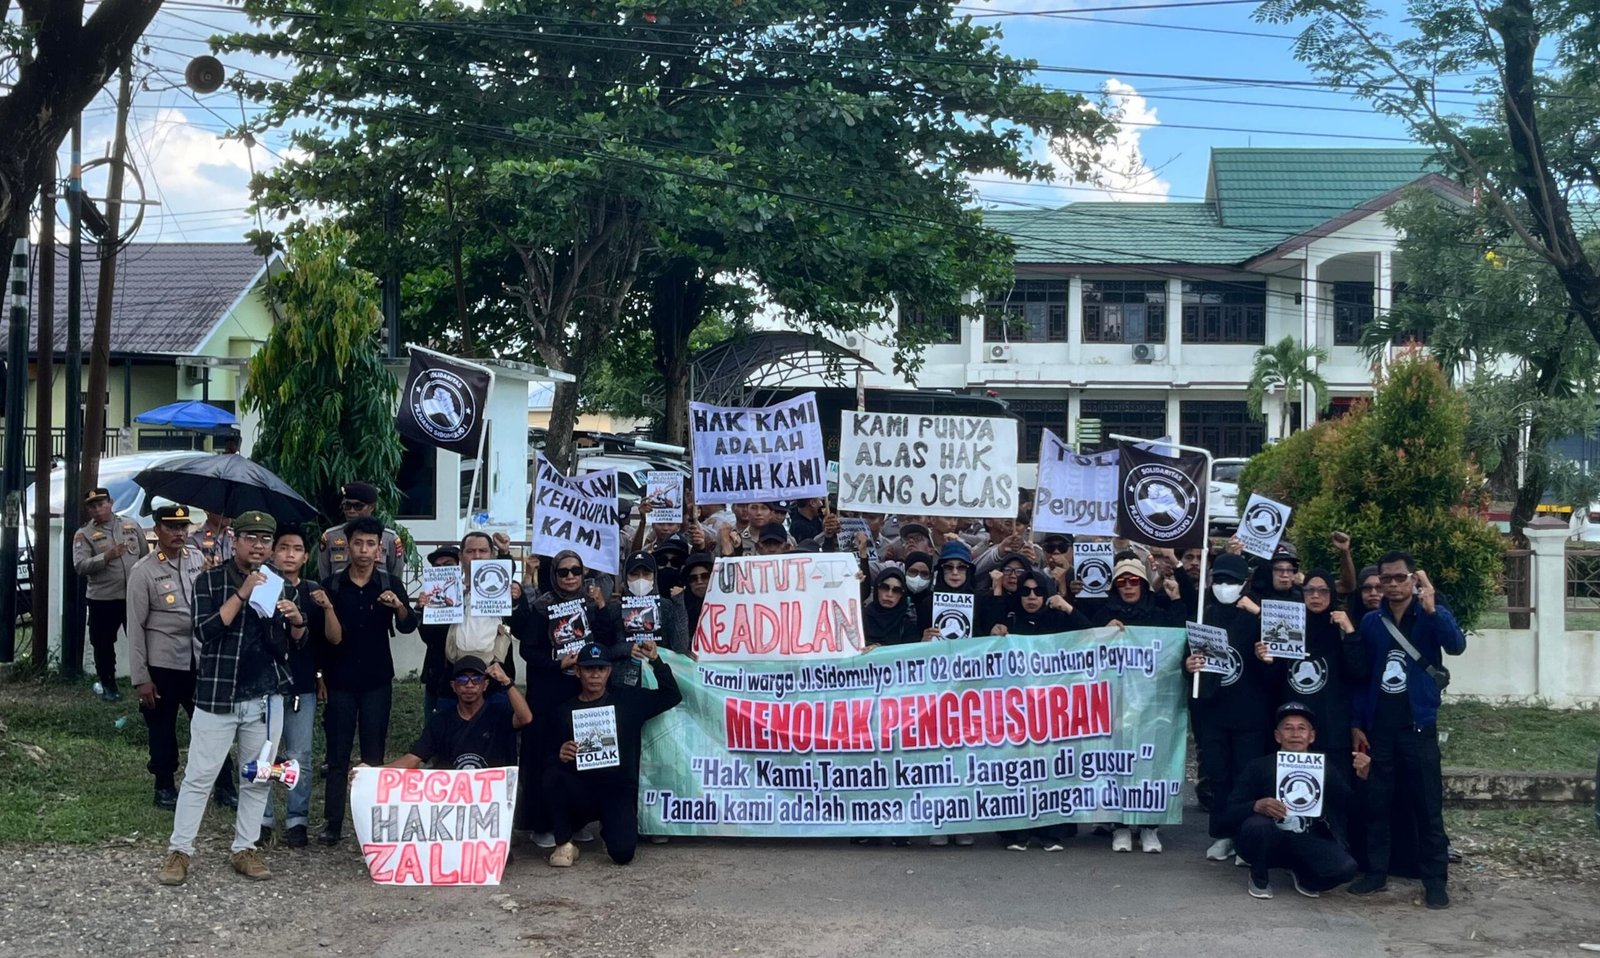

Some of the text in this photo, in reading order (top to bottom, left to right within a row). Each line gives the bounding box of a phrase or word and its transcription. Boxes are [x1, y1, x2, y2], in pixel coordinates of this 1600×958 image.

[414, 403, 433, 433] PEJUANG
[693, 401, 816, 432] HAK KAMI
[853, 413, 994, 441] KAMI PUNYA
[714, 430, 804, 455] ADALAH
[855, 441, 993, 471] ALAS HAK
[575, 474, 617, 498] KAMI
[698, 457, 821, 493] TANAH KAMI
[1140, 467, 1183, 482] SOLIDARITAS
[536, 485, 619, 526] KEHIDUPAN
[841, 472, 1012, 509] YANG JELAS
[541, 516, 601, 551] KAMI
[1129, 505, 1154, 535] PEJUANG
[1154, 518, 1191, 538] SIDOMULYO
[1075, 544, 1111, 552] TOLAK
[547, 598, 586, 611] SOLIDARITAS
[934, 594, 972, 604] TOLAK
[1263, 604, 1300, 612] SIDOMULYO
[693, 598, 861, 655] KEADILAN
[1263, 612, 1300, 620] SIDOMULYO
[699, 641, 1161, 697] "Kami warga Jl.Sidomulyo 1 RT 02 dan RT 03 Guntung Payung"
[574, 711, 610, 720] SIDOMULYO
[575, 720, 611, 728] SIDOMULYO
[725, 681, 1111, 750] MENOLAK PENGGUSURAN
[578, 750, 617, 763] TOLAK
[692, 758, 749, 787] "Hak
[756, 758, 888, 790] Kami,Tanah
[896, 756, 959, 786] kami.
[966, 755, 1046, 786] Jangan
[1054, 749, 1073, 777] di
[1081, 751, 1135, 778] gusur
[1278, 753, 1322, 765] TOLAK
[661, 792, 717, 822] Tanah
[724, 795, 772, 822] kami
[779, 794, 845, 822] adalah
[852, 800, 903, 822] masa
[910, 792, 969, 826] depan
[976, 789, 1025, 817] kami
[1031, 786, 1095, 818] jangan
[371, 802, 500, 843] HAKIM
[363, 841, 508, 885] ZALIM
